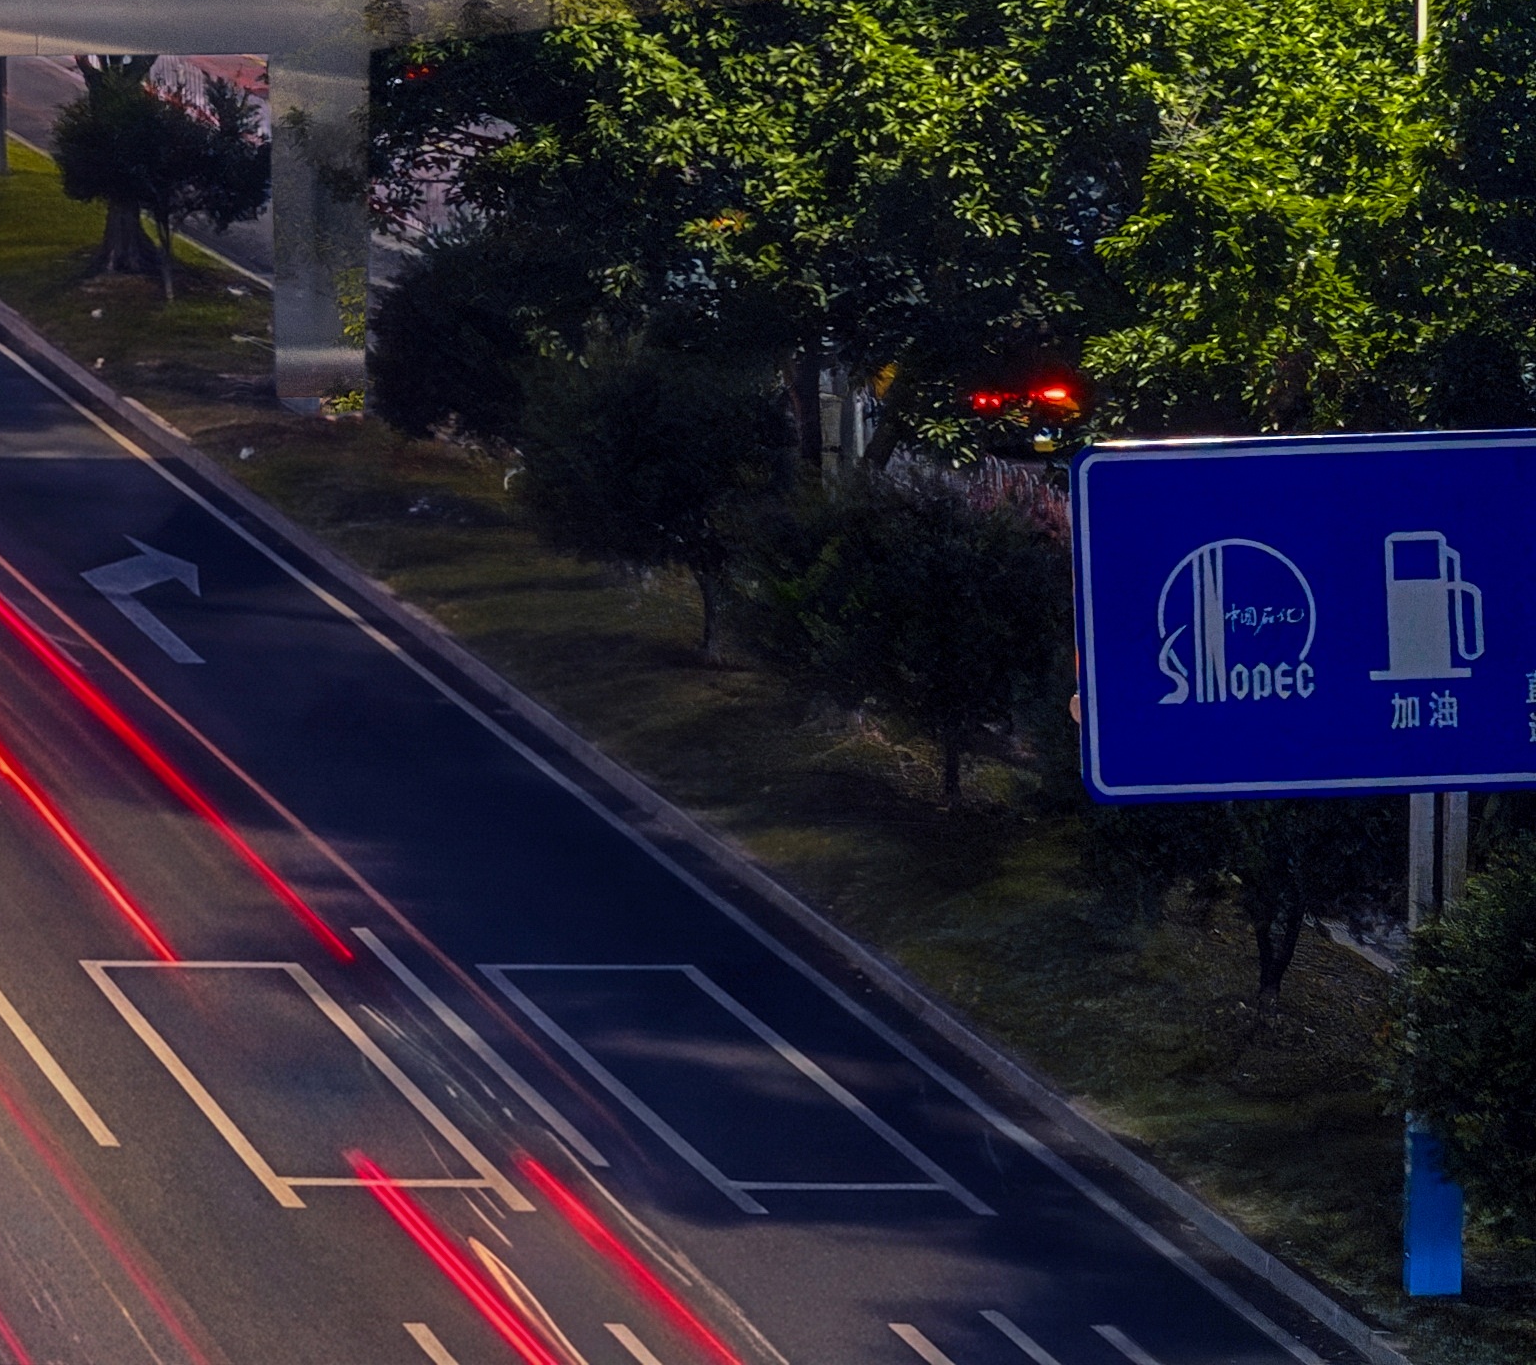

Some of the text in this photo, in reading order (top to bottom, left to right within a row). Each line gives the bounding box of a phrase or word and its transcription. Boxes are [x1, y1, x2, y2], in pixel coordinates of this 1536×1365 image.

[1225, 603, 1305, 636] 中国石化
[1391, 689, 1459, 730] 加油
